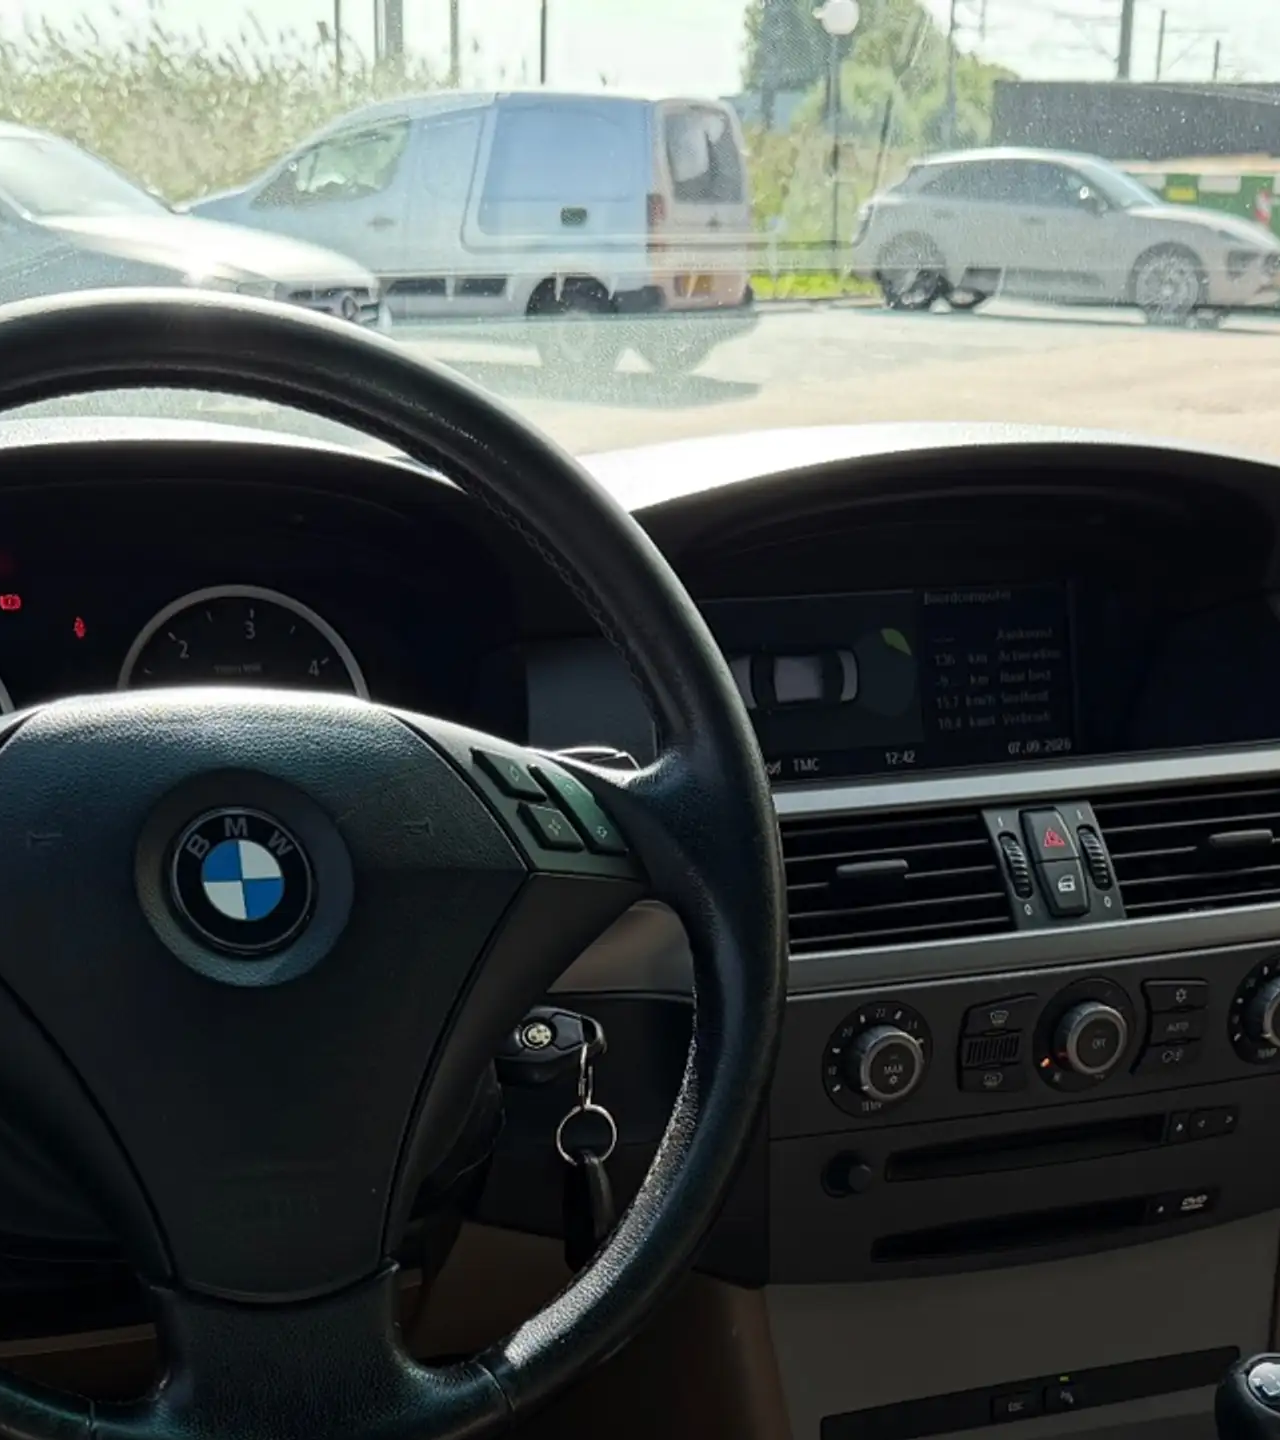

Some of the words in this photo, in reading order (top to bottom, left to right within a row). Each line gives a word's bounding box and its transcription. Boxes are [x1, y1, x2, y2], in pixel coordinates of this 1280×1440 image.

[243, 619, 256, 640] 3
[177, 639, 191, 659] 2
[308, 659, 320, 677] 4
[792, 757, 820, 773] TMC
[884, 749, 917, 765] 12:42
[186, 816, 294, 860] BMW
[1091, 1037, 1108, 1049] OFF
